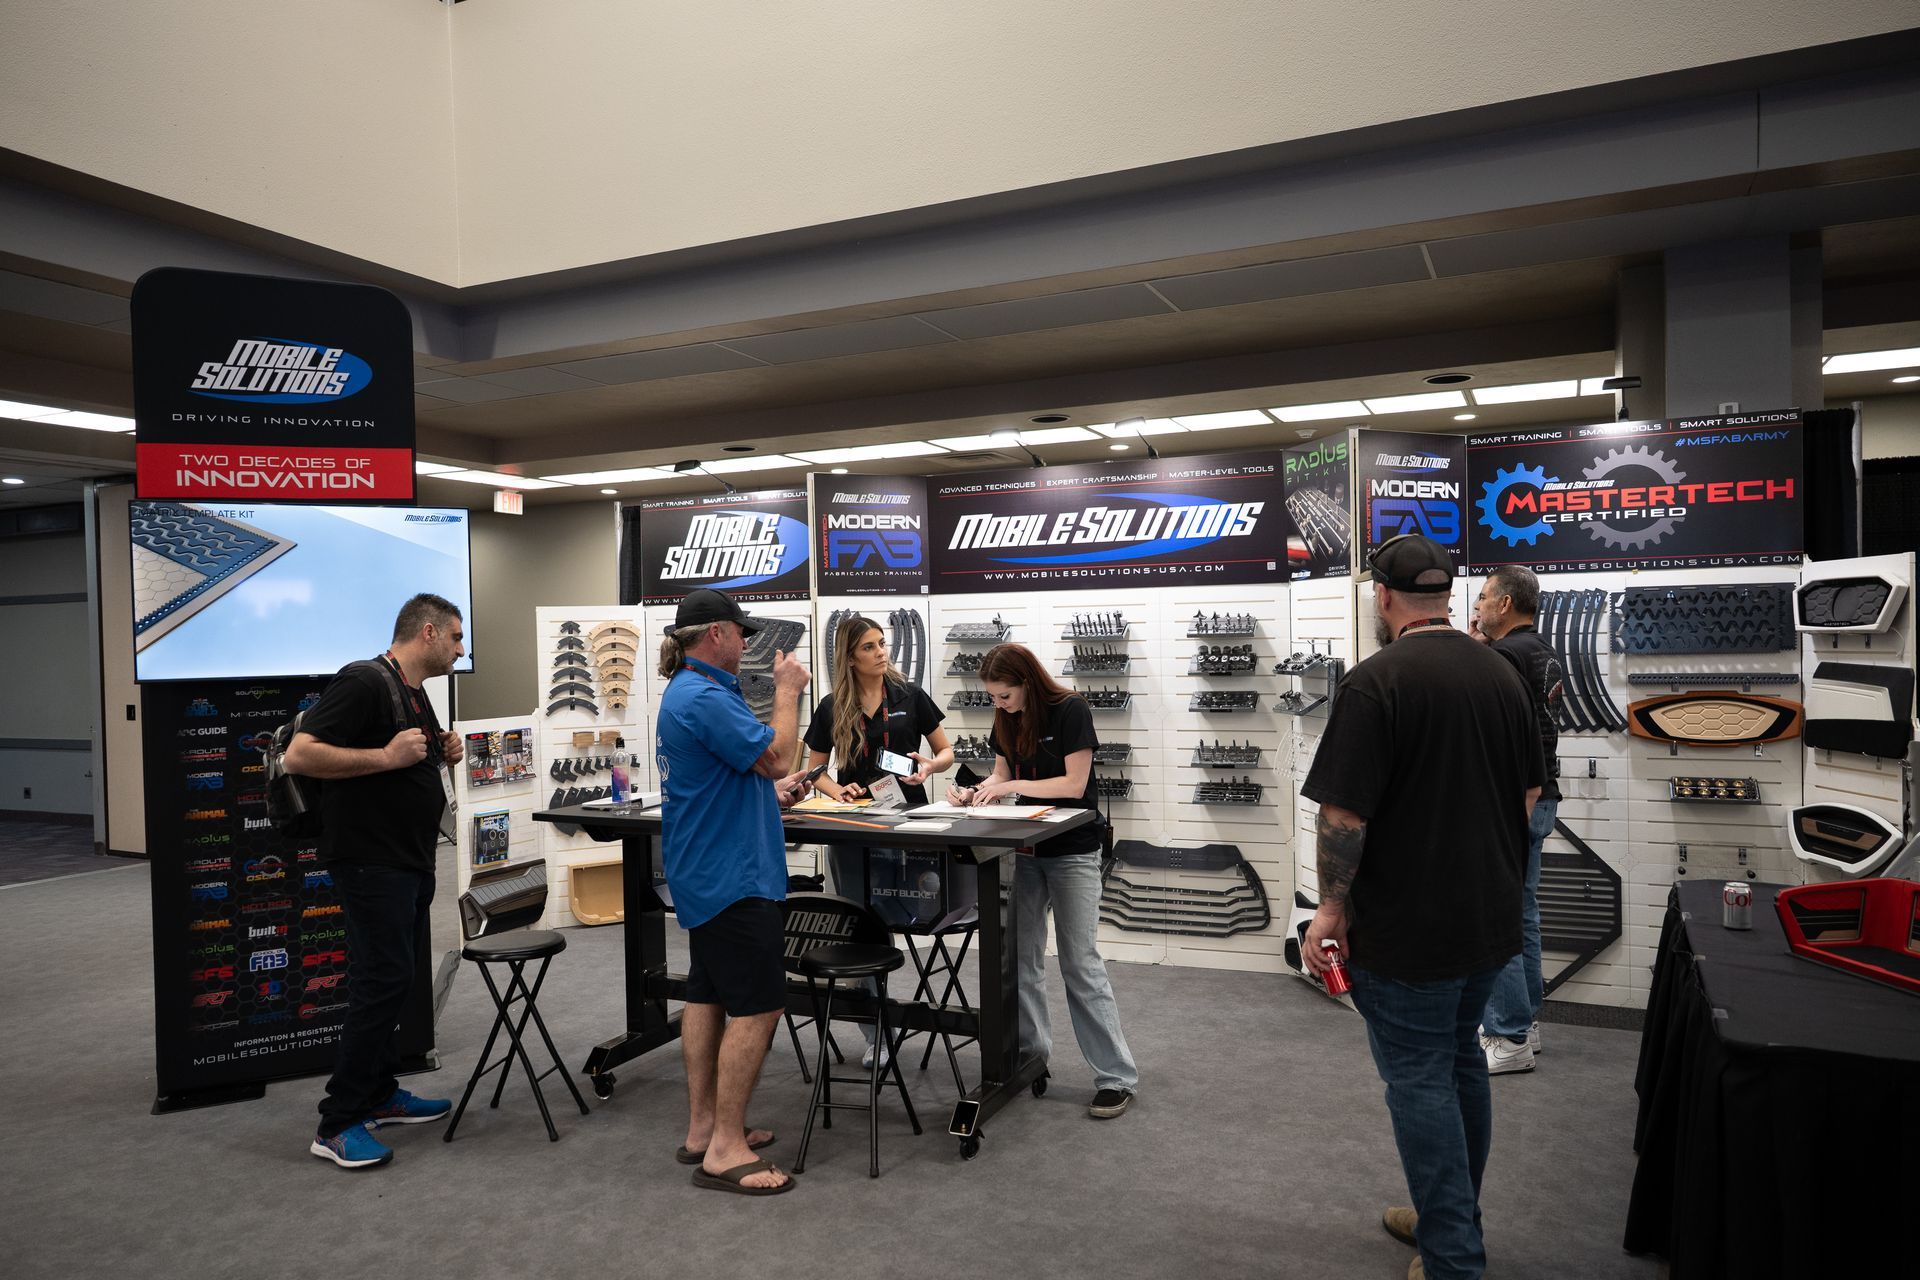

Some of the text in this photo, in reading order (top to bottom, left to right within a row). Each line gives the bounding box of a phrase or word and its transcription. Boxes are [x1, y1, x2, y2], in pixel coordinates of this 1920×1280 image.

[226, 339, 344, 371] MOBILE
[191, 362, 350, 395] SOLUTIONS
[172, 412, 376, 428] DRIVING INNOVATION
[1470, 436, 1508, 445] SMART
[1511, 432, 1562, 442] TRAINING
[1680, 418, 1723, 429] SMART
[1726, 413, 1798, 425] SOLUTIONS
[1675, 430, 1790, 447] #MSFABARMY
[179, 454, 372, 469] TWO DECADES OF
[176, 469, 375, 489] INNOVATION
[939, 485, 982, 495] ADVANCED
[984, 481, 1036, 491] TECHNIQUES
[1046, 478, 1080, 487] EXPERT
[1082, 473, 1158, 484] CRAFTSMANSHIP
[1168, 468, 1239, 479] MASTER-LEVEL
[782, 491, 808, 499] SOLUTI
[1372, 479, 1460, 500] MODERN
[1505, 478, 1795, 515] MASTERTECH
[502, 492, 520, 513] EXIT
[182, 510, 236, 518] TEMPLATE
[238, 510, 255, 519] KIT
[828, 514, 921, 530] MODERN
[1372, 500, 1460, 545] FAB
[1542, 507, 1687, 523] CERTIFIED
[683, 514, 782, 550] MOBILE
[828, 530, 922, 569] FAB
[660, 544, 786, 580] SOLUTIONS
[984, 564, 1225, 580] WWW.MOBILESOLUTIONS-USA.COM
[198, 726, 228, 736] GUIDE
[872, 888, 937, 900] DUST BUCKET
[784, 910, 860, 937] MOBILE
[234, 1034, 289, 1048] INFORMATION
